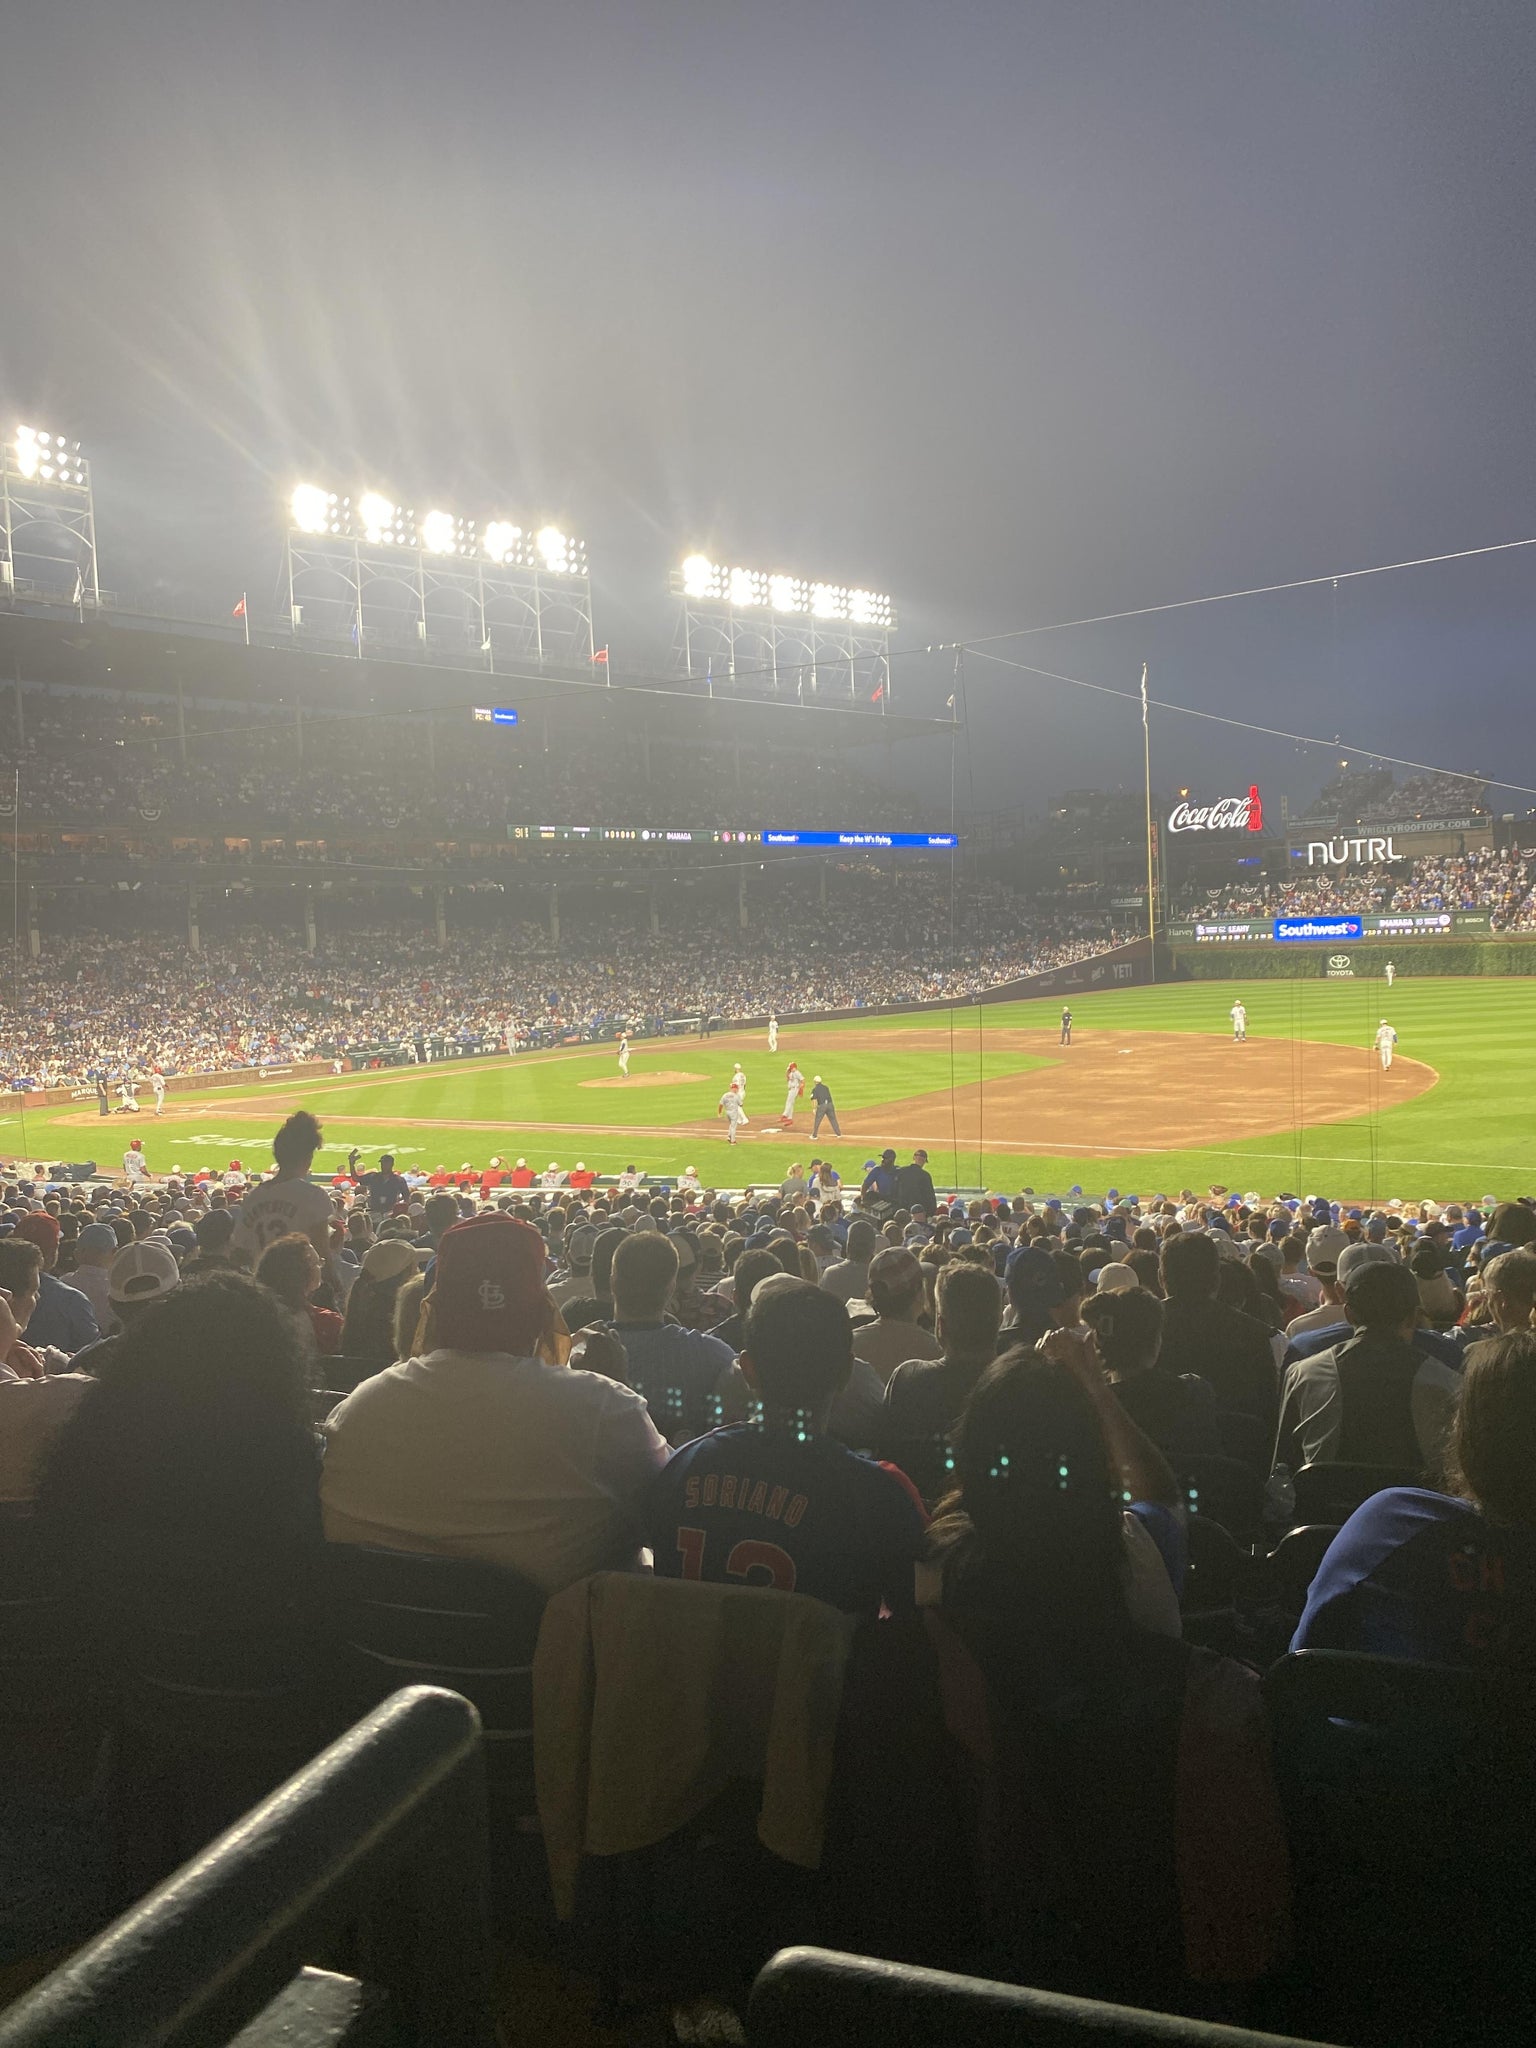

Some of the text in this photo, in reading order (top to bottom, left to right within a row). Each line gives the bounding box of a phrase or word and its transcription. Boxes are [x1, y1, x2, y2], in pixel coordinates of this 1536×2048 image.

[1168, 796, 1253, 832] Coca-Cola
[839, 834, 853, 845] Keep
[854, 834, 864, 843] the
[1168, 927, 1194, 939] Harvey
[1279, 922, 1348, 937] Southwest
[1112, 963, 1134, 979] YETI
[71, 1087, 98, 1099] MARQUE
[684, 1473, 809, 1528] SORIANO
